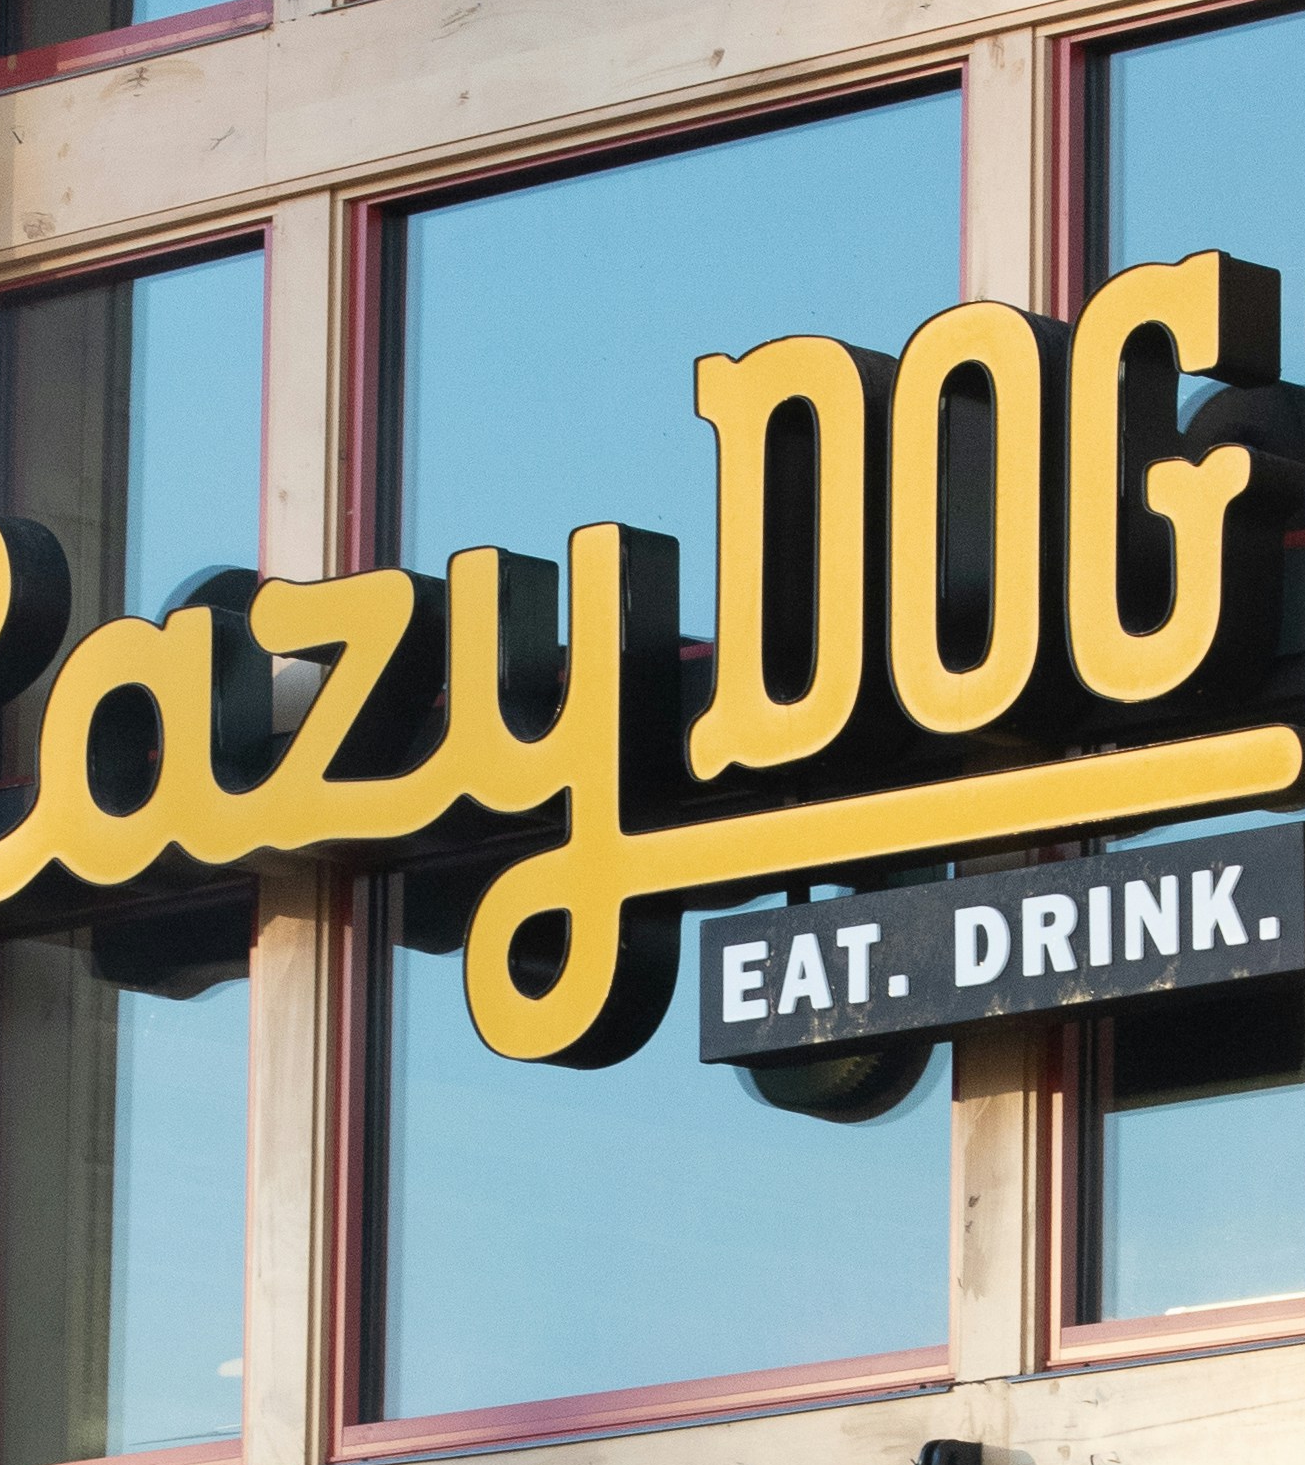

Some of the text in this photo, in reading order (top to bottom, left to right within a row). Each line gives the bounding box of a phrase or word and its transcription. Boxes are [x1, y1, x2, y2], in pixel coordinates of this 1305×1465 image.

[689, 248, 1251, 782] DOG
[721, 864, 1281, 1024] EAT. DRINK.
